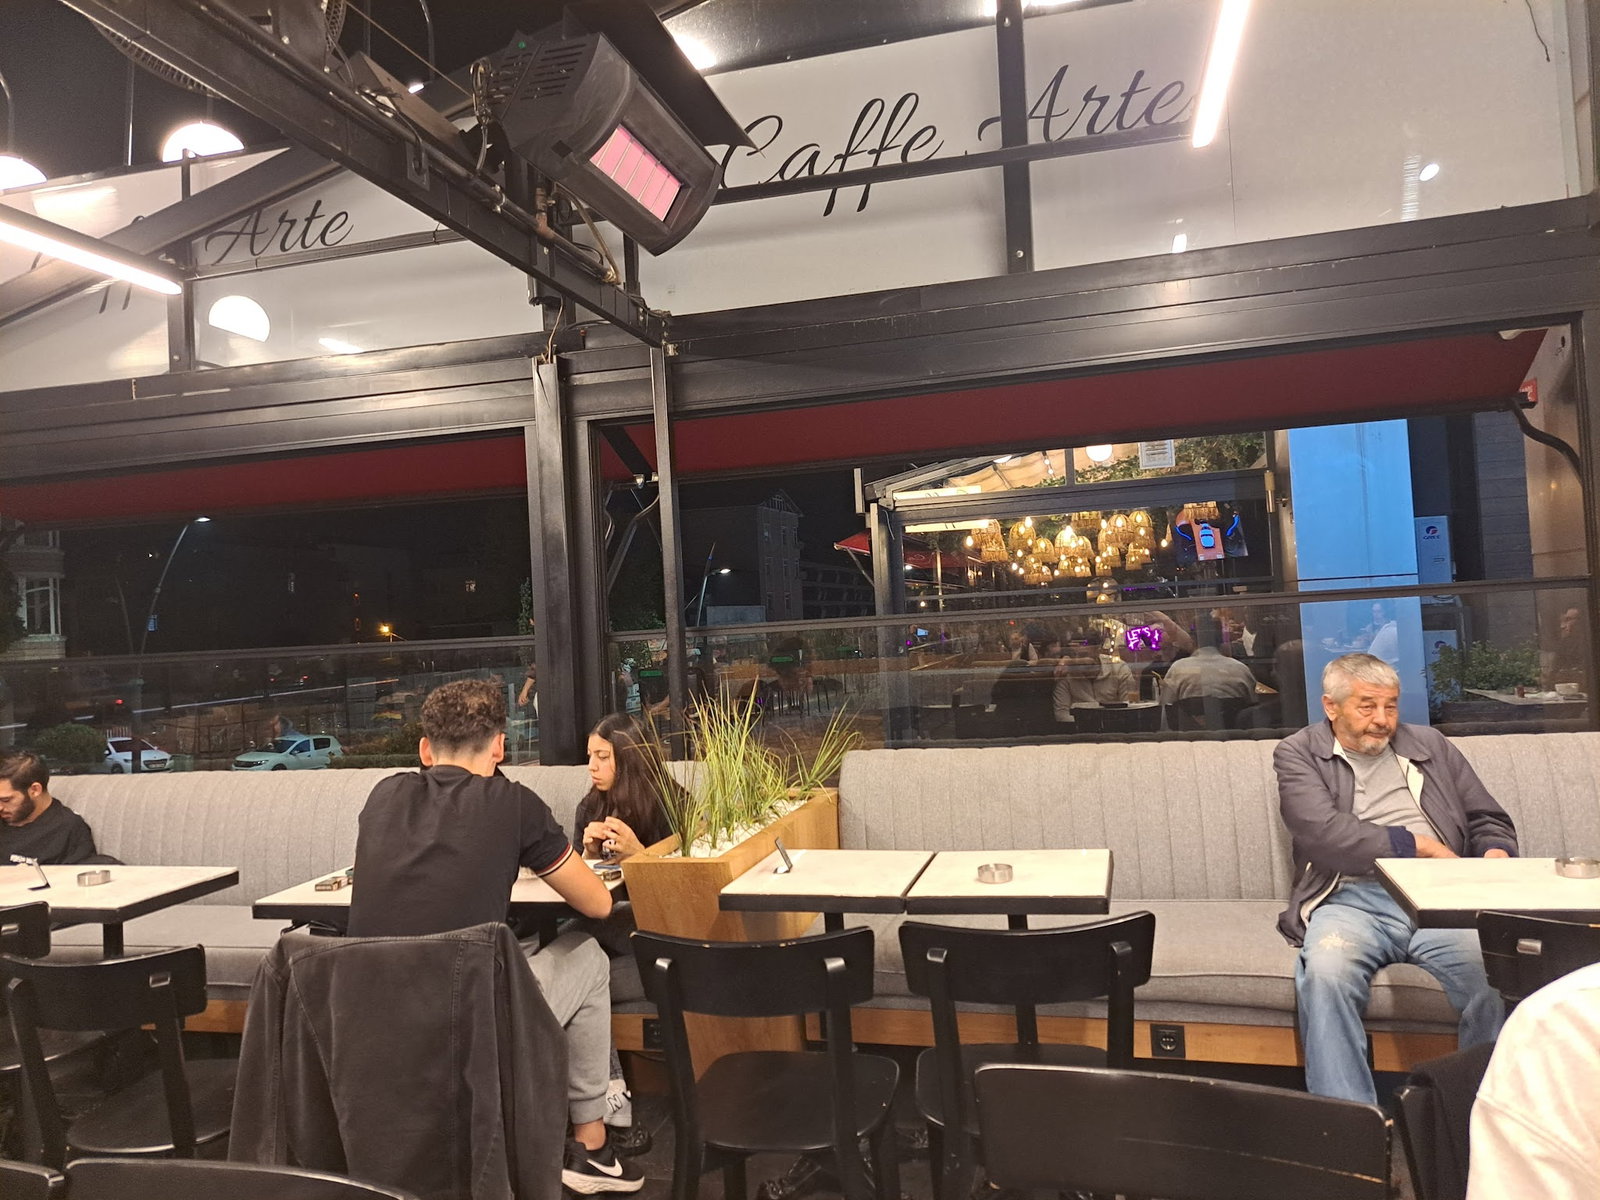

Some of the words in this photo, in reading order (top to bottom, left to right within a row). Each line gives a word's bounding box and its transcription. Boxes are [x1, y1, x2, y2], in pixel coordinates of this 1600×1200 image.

[720, 92, 944, 216] Caffe
[977, 64, 1193, 143] Arte
[205, 200, 354, 266] Arte
